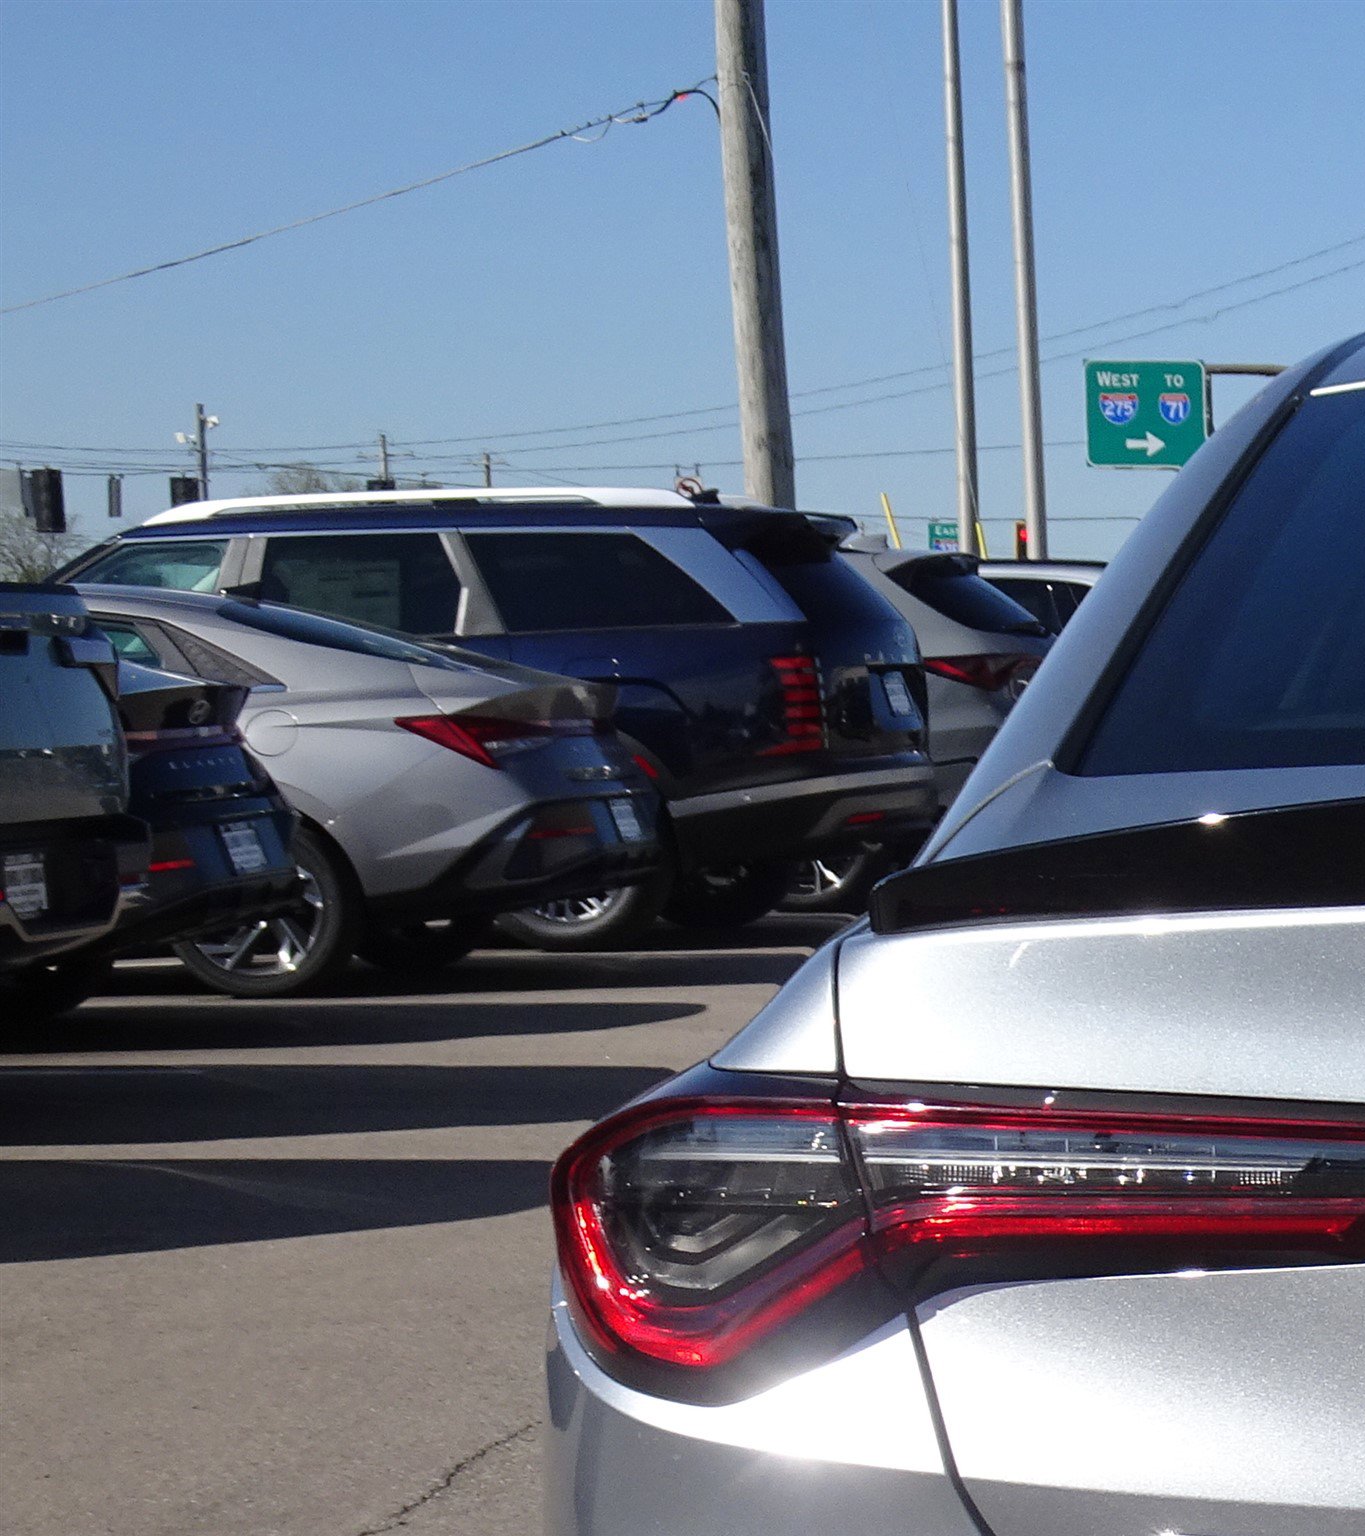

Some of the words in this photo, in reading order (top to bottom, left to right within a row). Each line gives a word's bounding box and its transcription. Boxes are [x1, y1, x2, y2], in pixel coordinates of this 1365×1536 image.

[1096, 371, 1139, 387] WEST
[1164, 374, 1184, 387] TO
[1105, 401, 1134, 416] 275
[1167, 402, 1184, 418] 71
